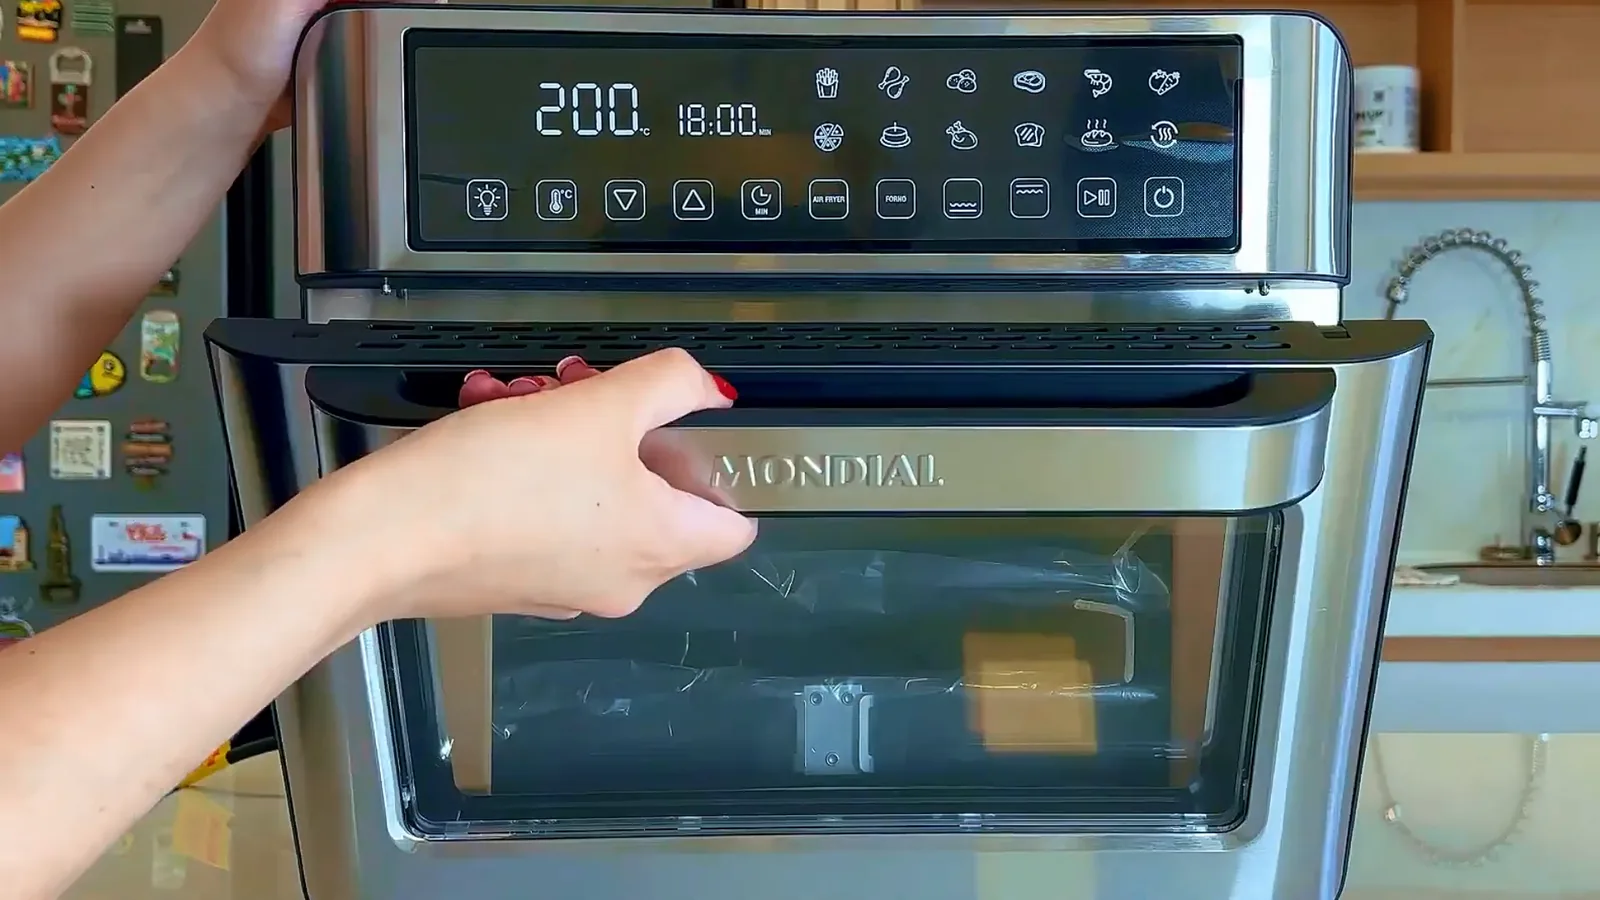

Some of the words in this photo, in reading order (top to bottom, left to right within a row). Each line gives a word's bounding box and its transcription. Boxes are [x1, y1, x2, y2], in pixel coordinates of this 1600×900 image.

[536, 82, 639, 136] 200
[678, 103, 757, 136] 18:00
[758, 128, 772, 136] MIN
[812, 195, 824, 203] AIR
[824, 195, 846, 203] FRYER
[885, 195, 907, 203] FORNO
[754, 208, 769, 216] MIN
[710, 454, 946, 487] MONDIAL
